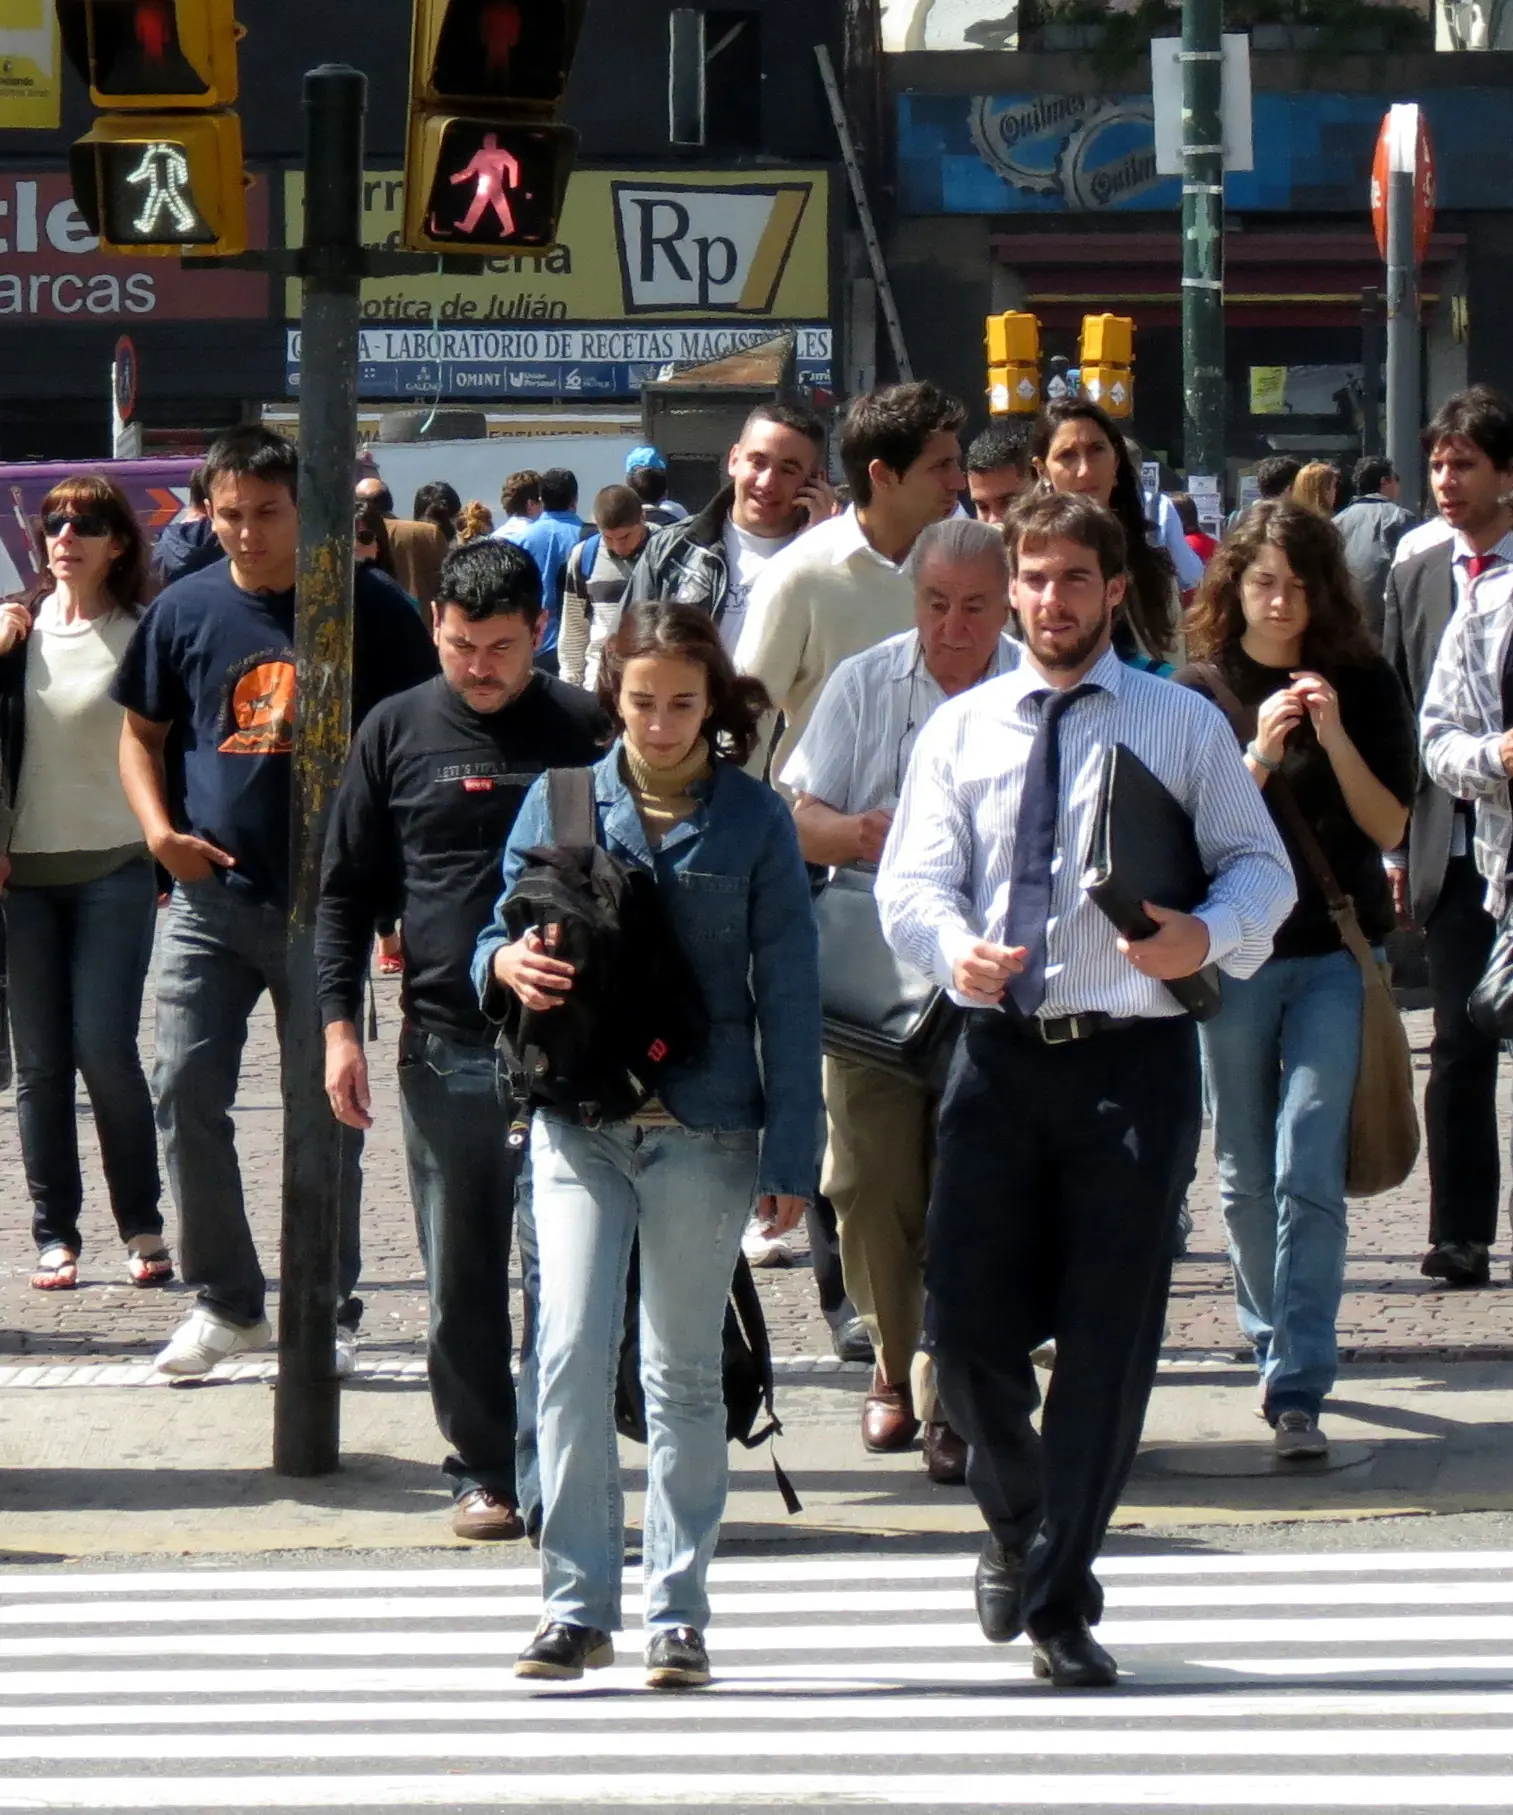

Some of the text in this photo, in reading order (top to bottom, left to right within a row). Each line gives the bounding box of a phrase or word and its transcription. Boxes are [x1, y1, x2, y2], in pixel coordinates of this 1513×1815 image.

[1000, 94, 1085, 148] Quilmes
[630, 198, 738, 303] Rp
[440, 293, 477, 319] de
[486, 293, 568, 320] Julián
[386, 332, 538, 359] LABORATORIO
[545, 332, 572, 358] DE
[581, 331, 674, 359] RECETAS
[456, 371, 501, 388] OMINT
